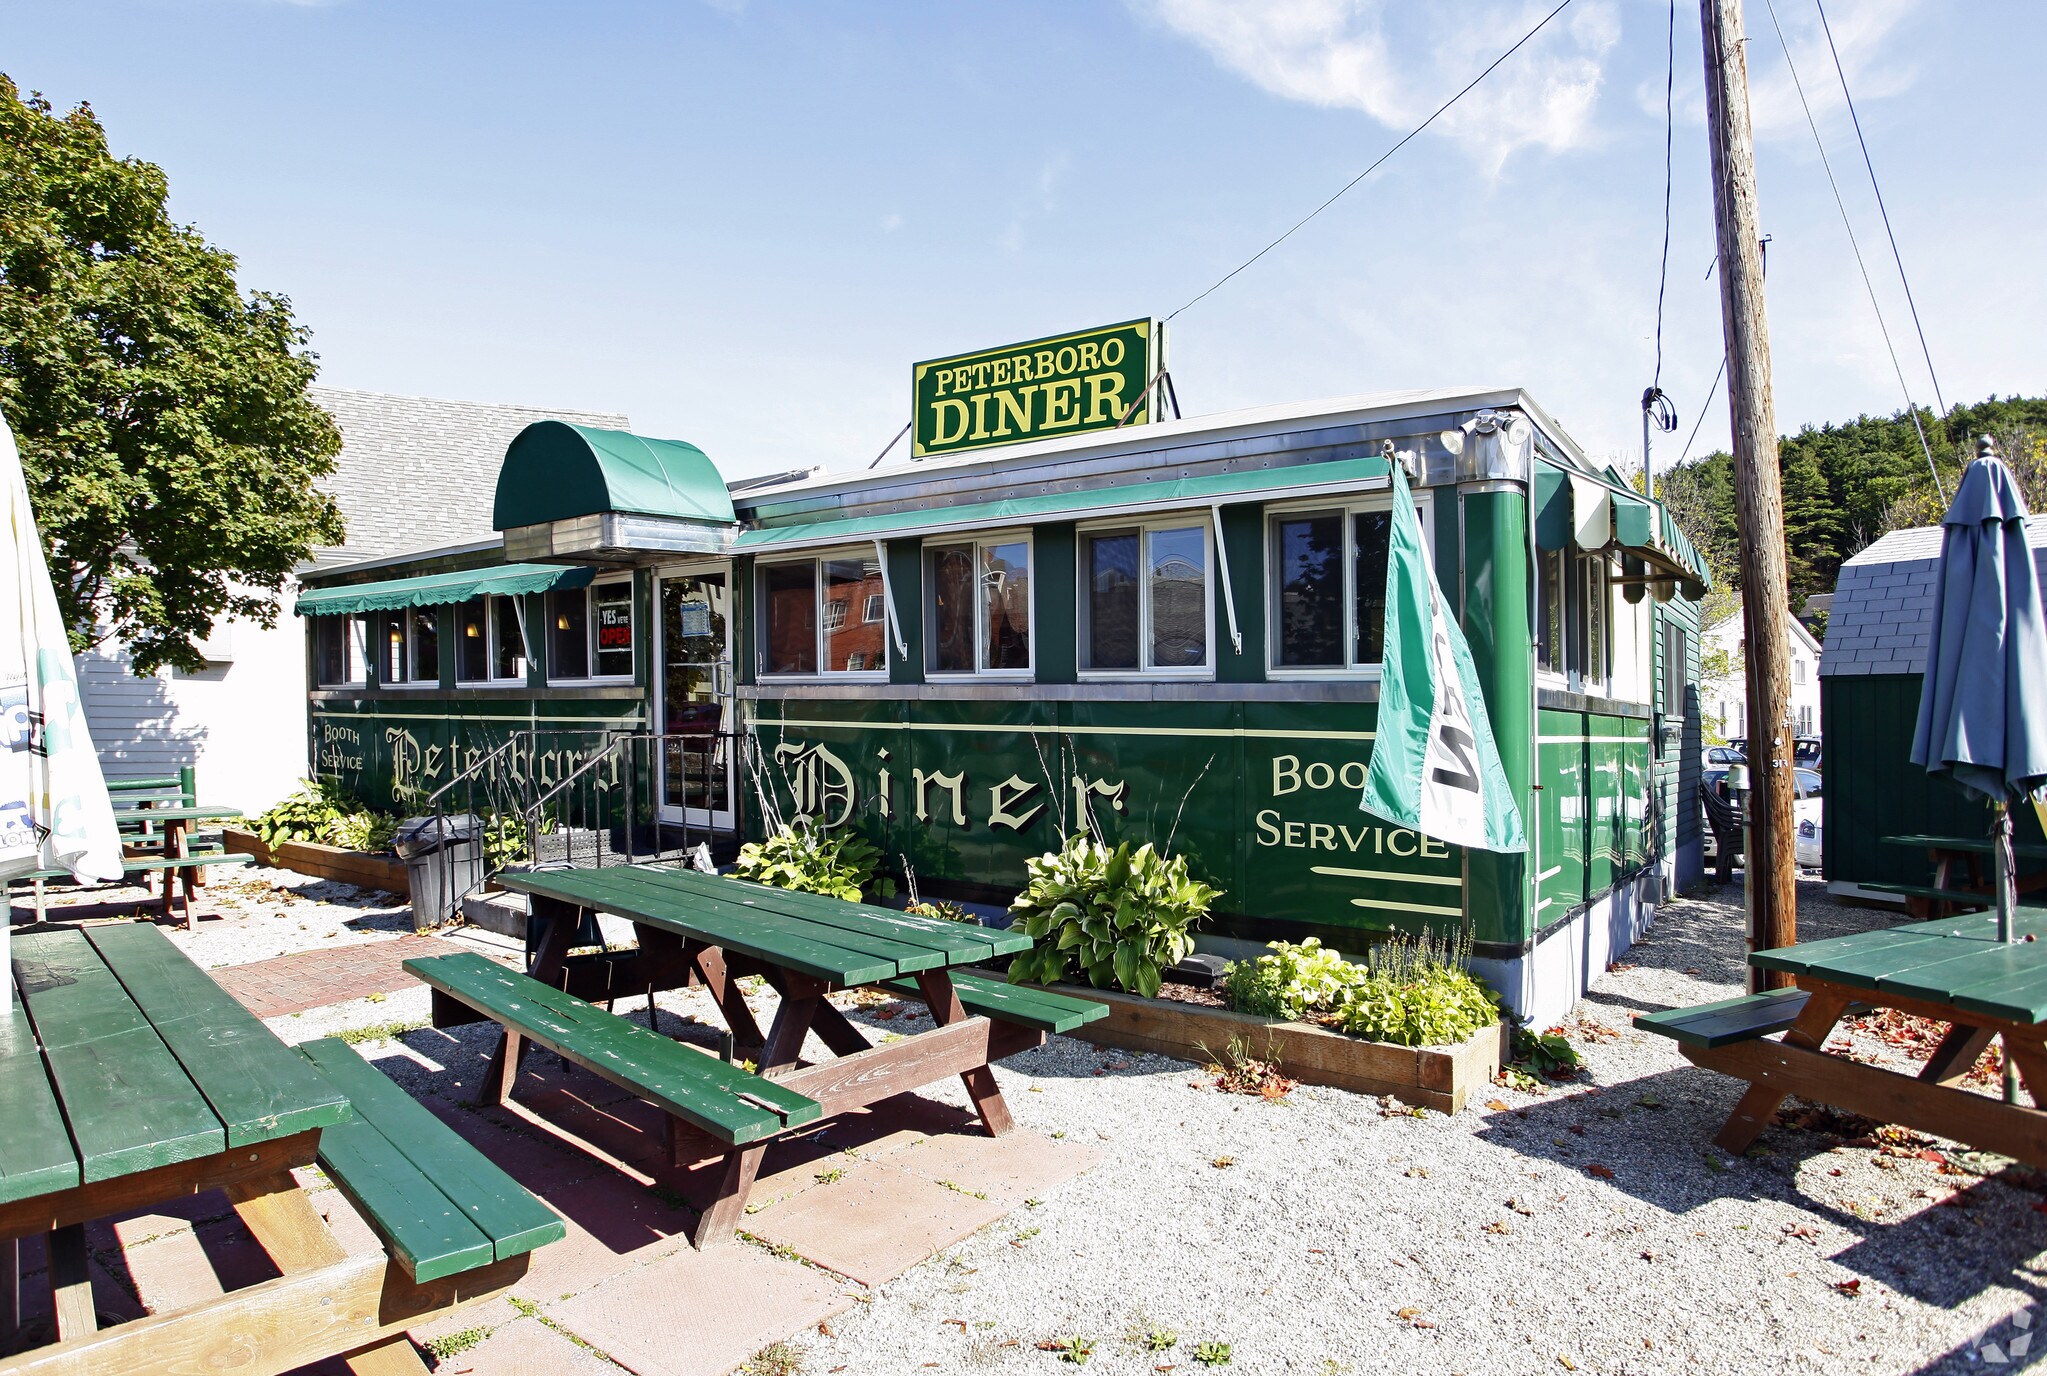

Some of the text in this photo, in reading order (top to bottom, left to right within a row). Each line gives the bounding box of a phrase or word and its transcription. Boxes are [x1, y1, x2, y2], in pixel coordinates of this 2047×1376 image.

[935, 337, 1126, 397] PETERBORO
[929, 371, 1131, 446] DINER
[600, 627, 631, 645] OPEN
[602, 609, 617, 625] YES
[324, 723, 360, 746] BOOTH
[320, 749, 364, 770] SERVICE
[1271, 754, 1370, 797] BOO
[774, 741, 1125, 833] Diner
[1255, 809, 1450, 859] SERVICE
